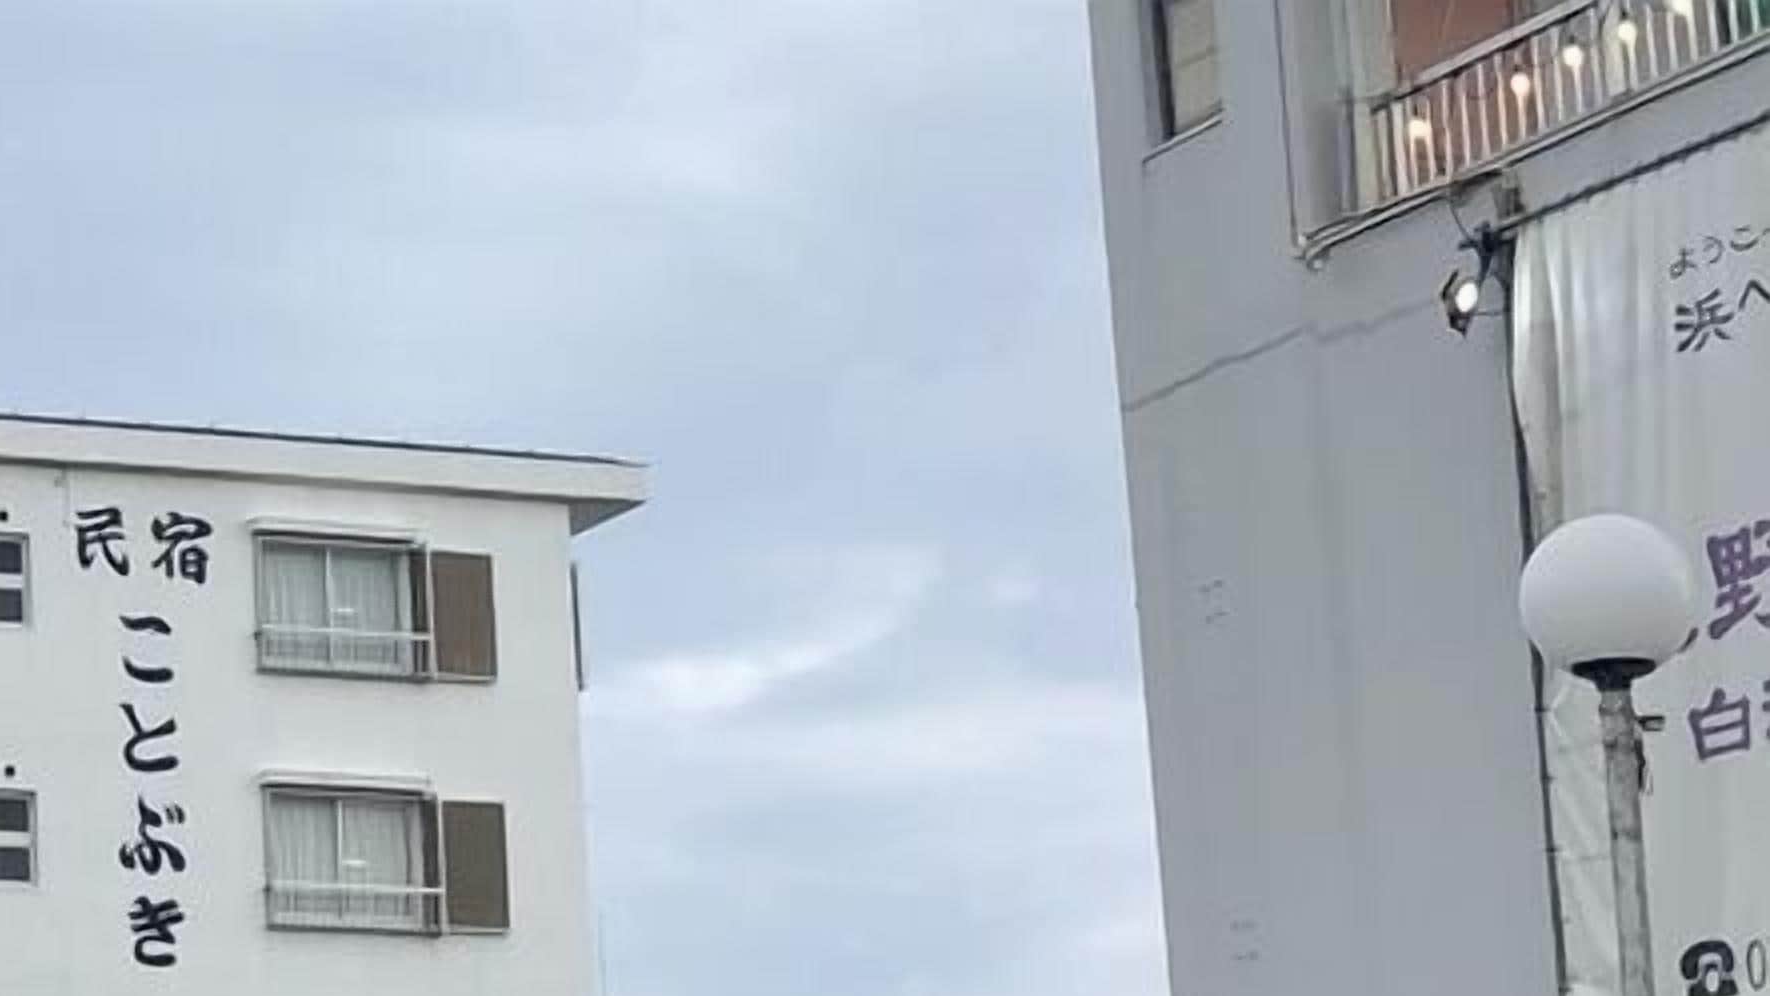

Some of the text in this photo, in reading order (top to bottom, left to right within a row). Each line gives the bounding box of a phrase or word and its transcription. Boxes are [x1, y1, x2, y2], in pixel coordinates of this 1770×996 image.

[75, 506, 213, 584] 民宿
[1687, 680, 1770, 761] 白
[118, 614, 187, 968] ことぶき
